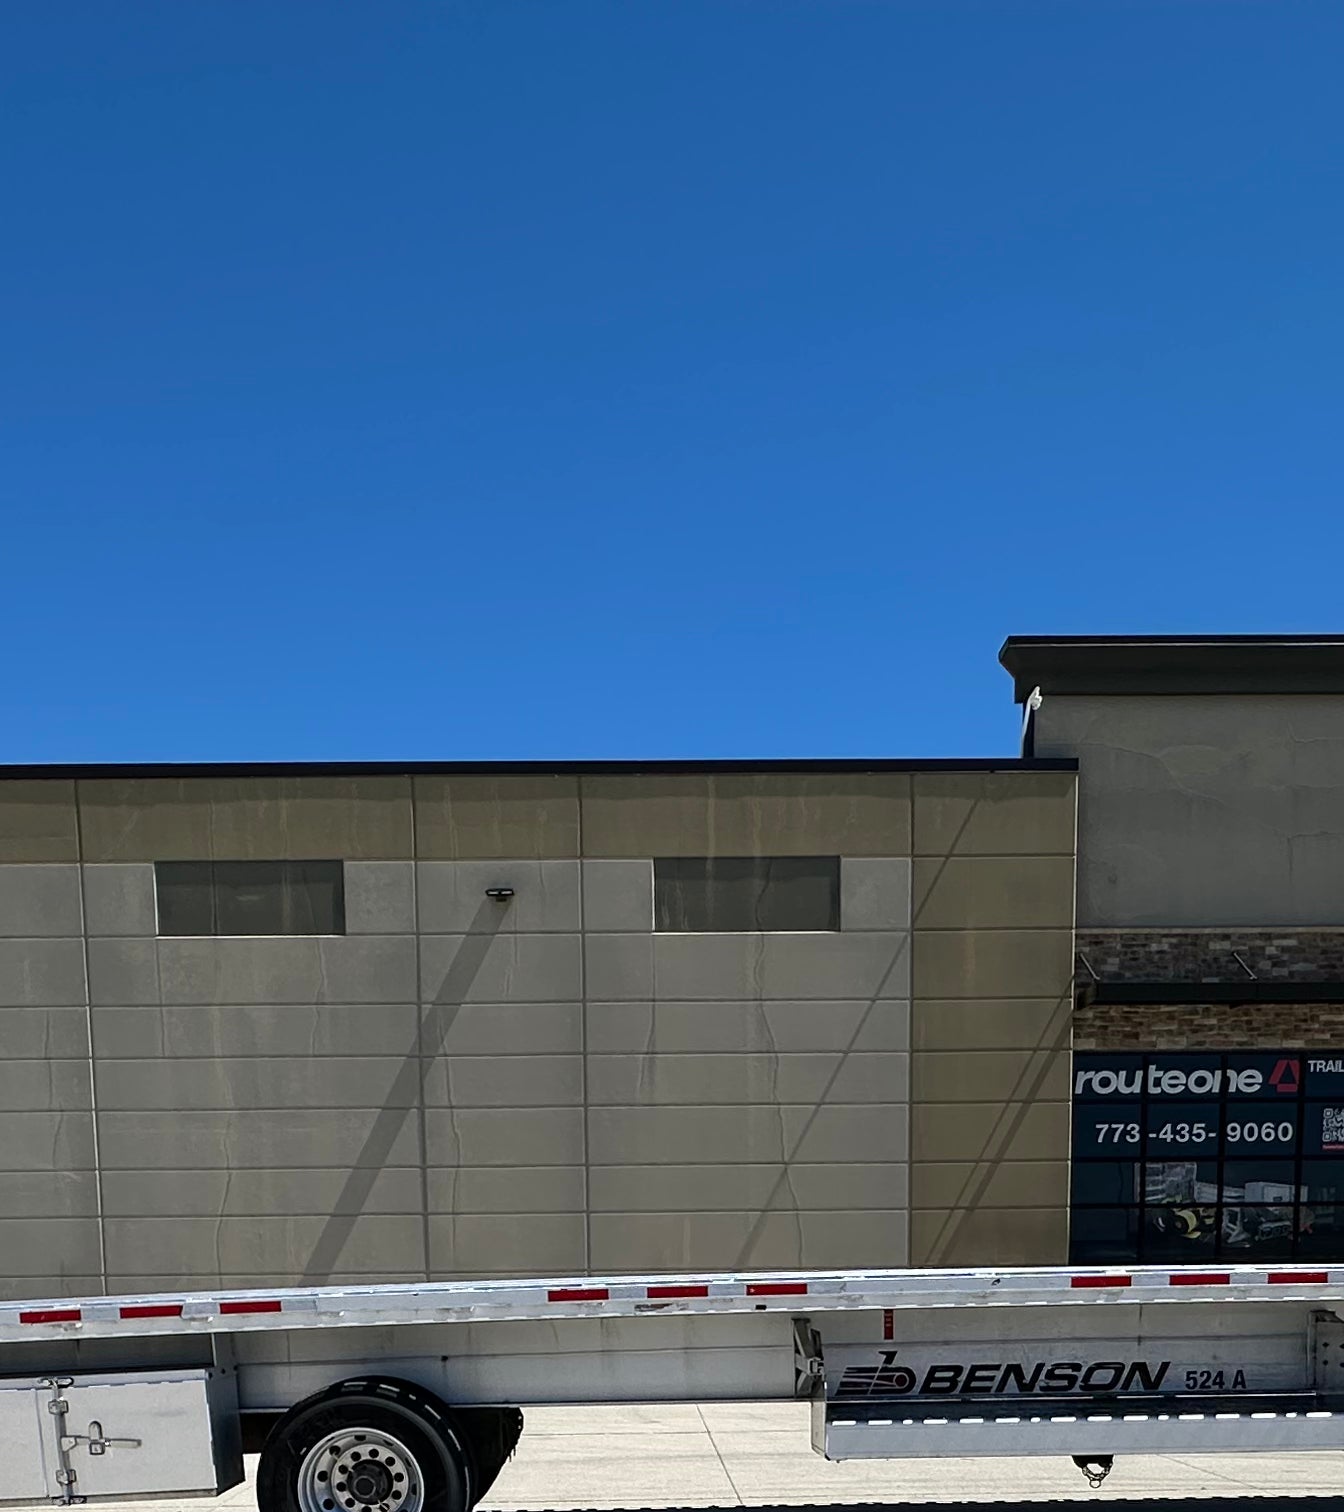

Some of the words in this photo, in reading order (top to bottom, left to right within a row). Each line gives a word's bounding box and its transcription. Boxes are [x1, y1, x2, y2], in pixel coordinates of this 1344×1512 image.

[1075, 1065, 1263, 1095] routeone
[918, 1361, 1172, 1395] BENSON
[1184, 1369, 1226, 1390] 524
[1232, 1368, 1247, 1390] A
